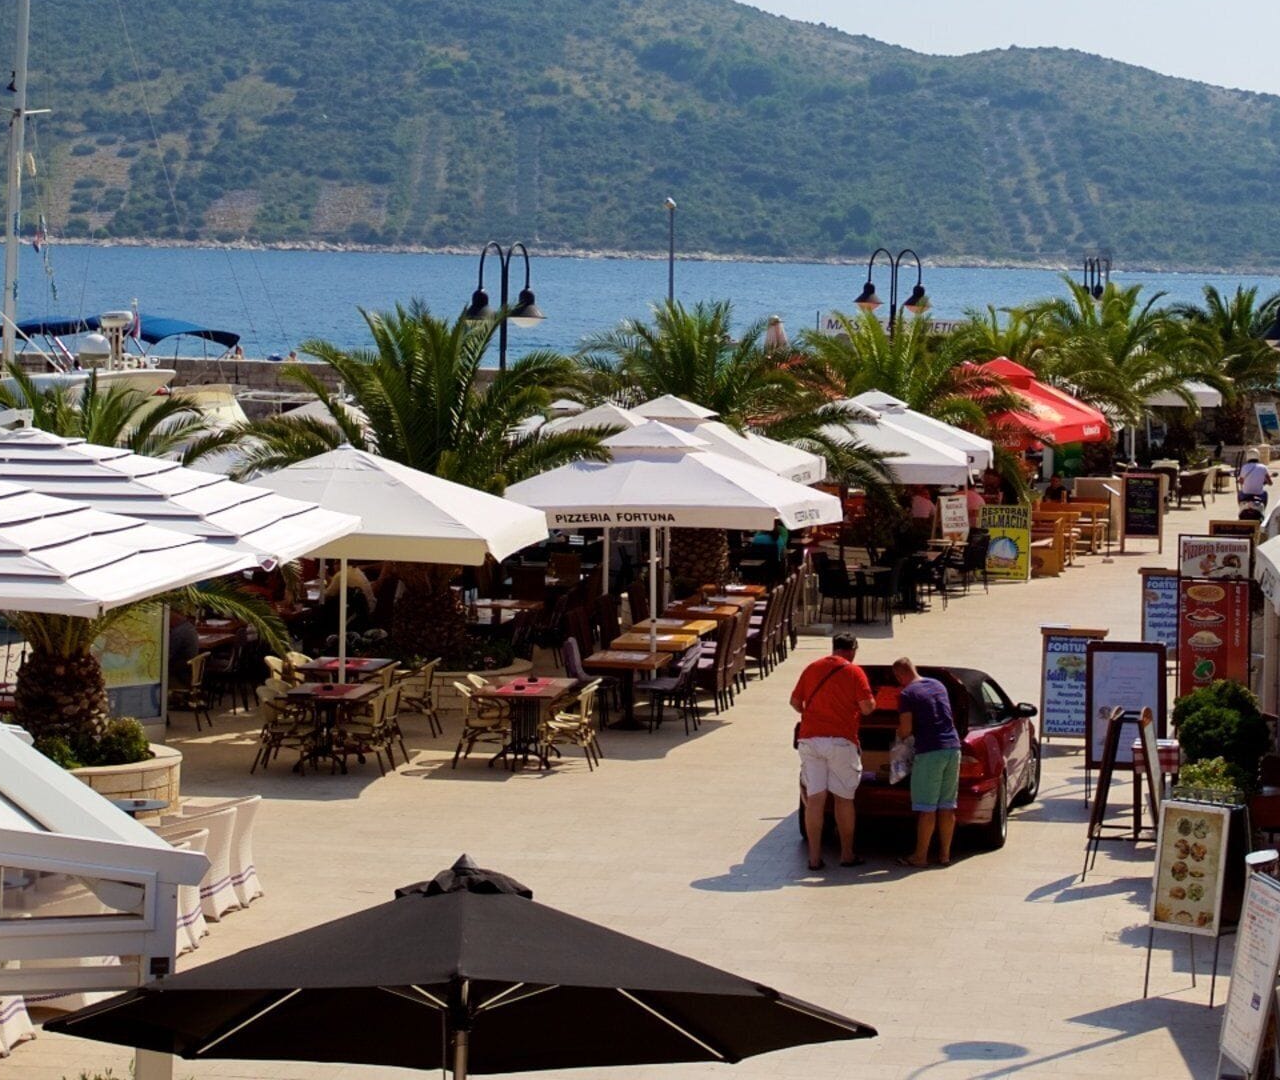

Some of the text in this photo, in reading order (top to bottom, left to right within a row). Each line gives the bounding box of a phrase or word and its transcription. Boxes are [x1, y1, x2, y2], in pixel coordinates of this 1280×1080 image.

[555, 512, 676, 524] PIZZERIA FORTUNA
[982, 507, 1028, 518] RESTORAN
